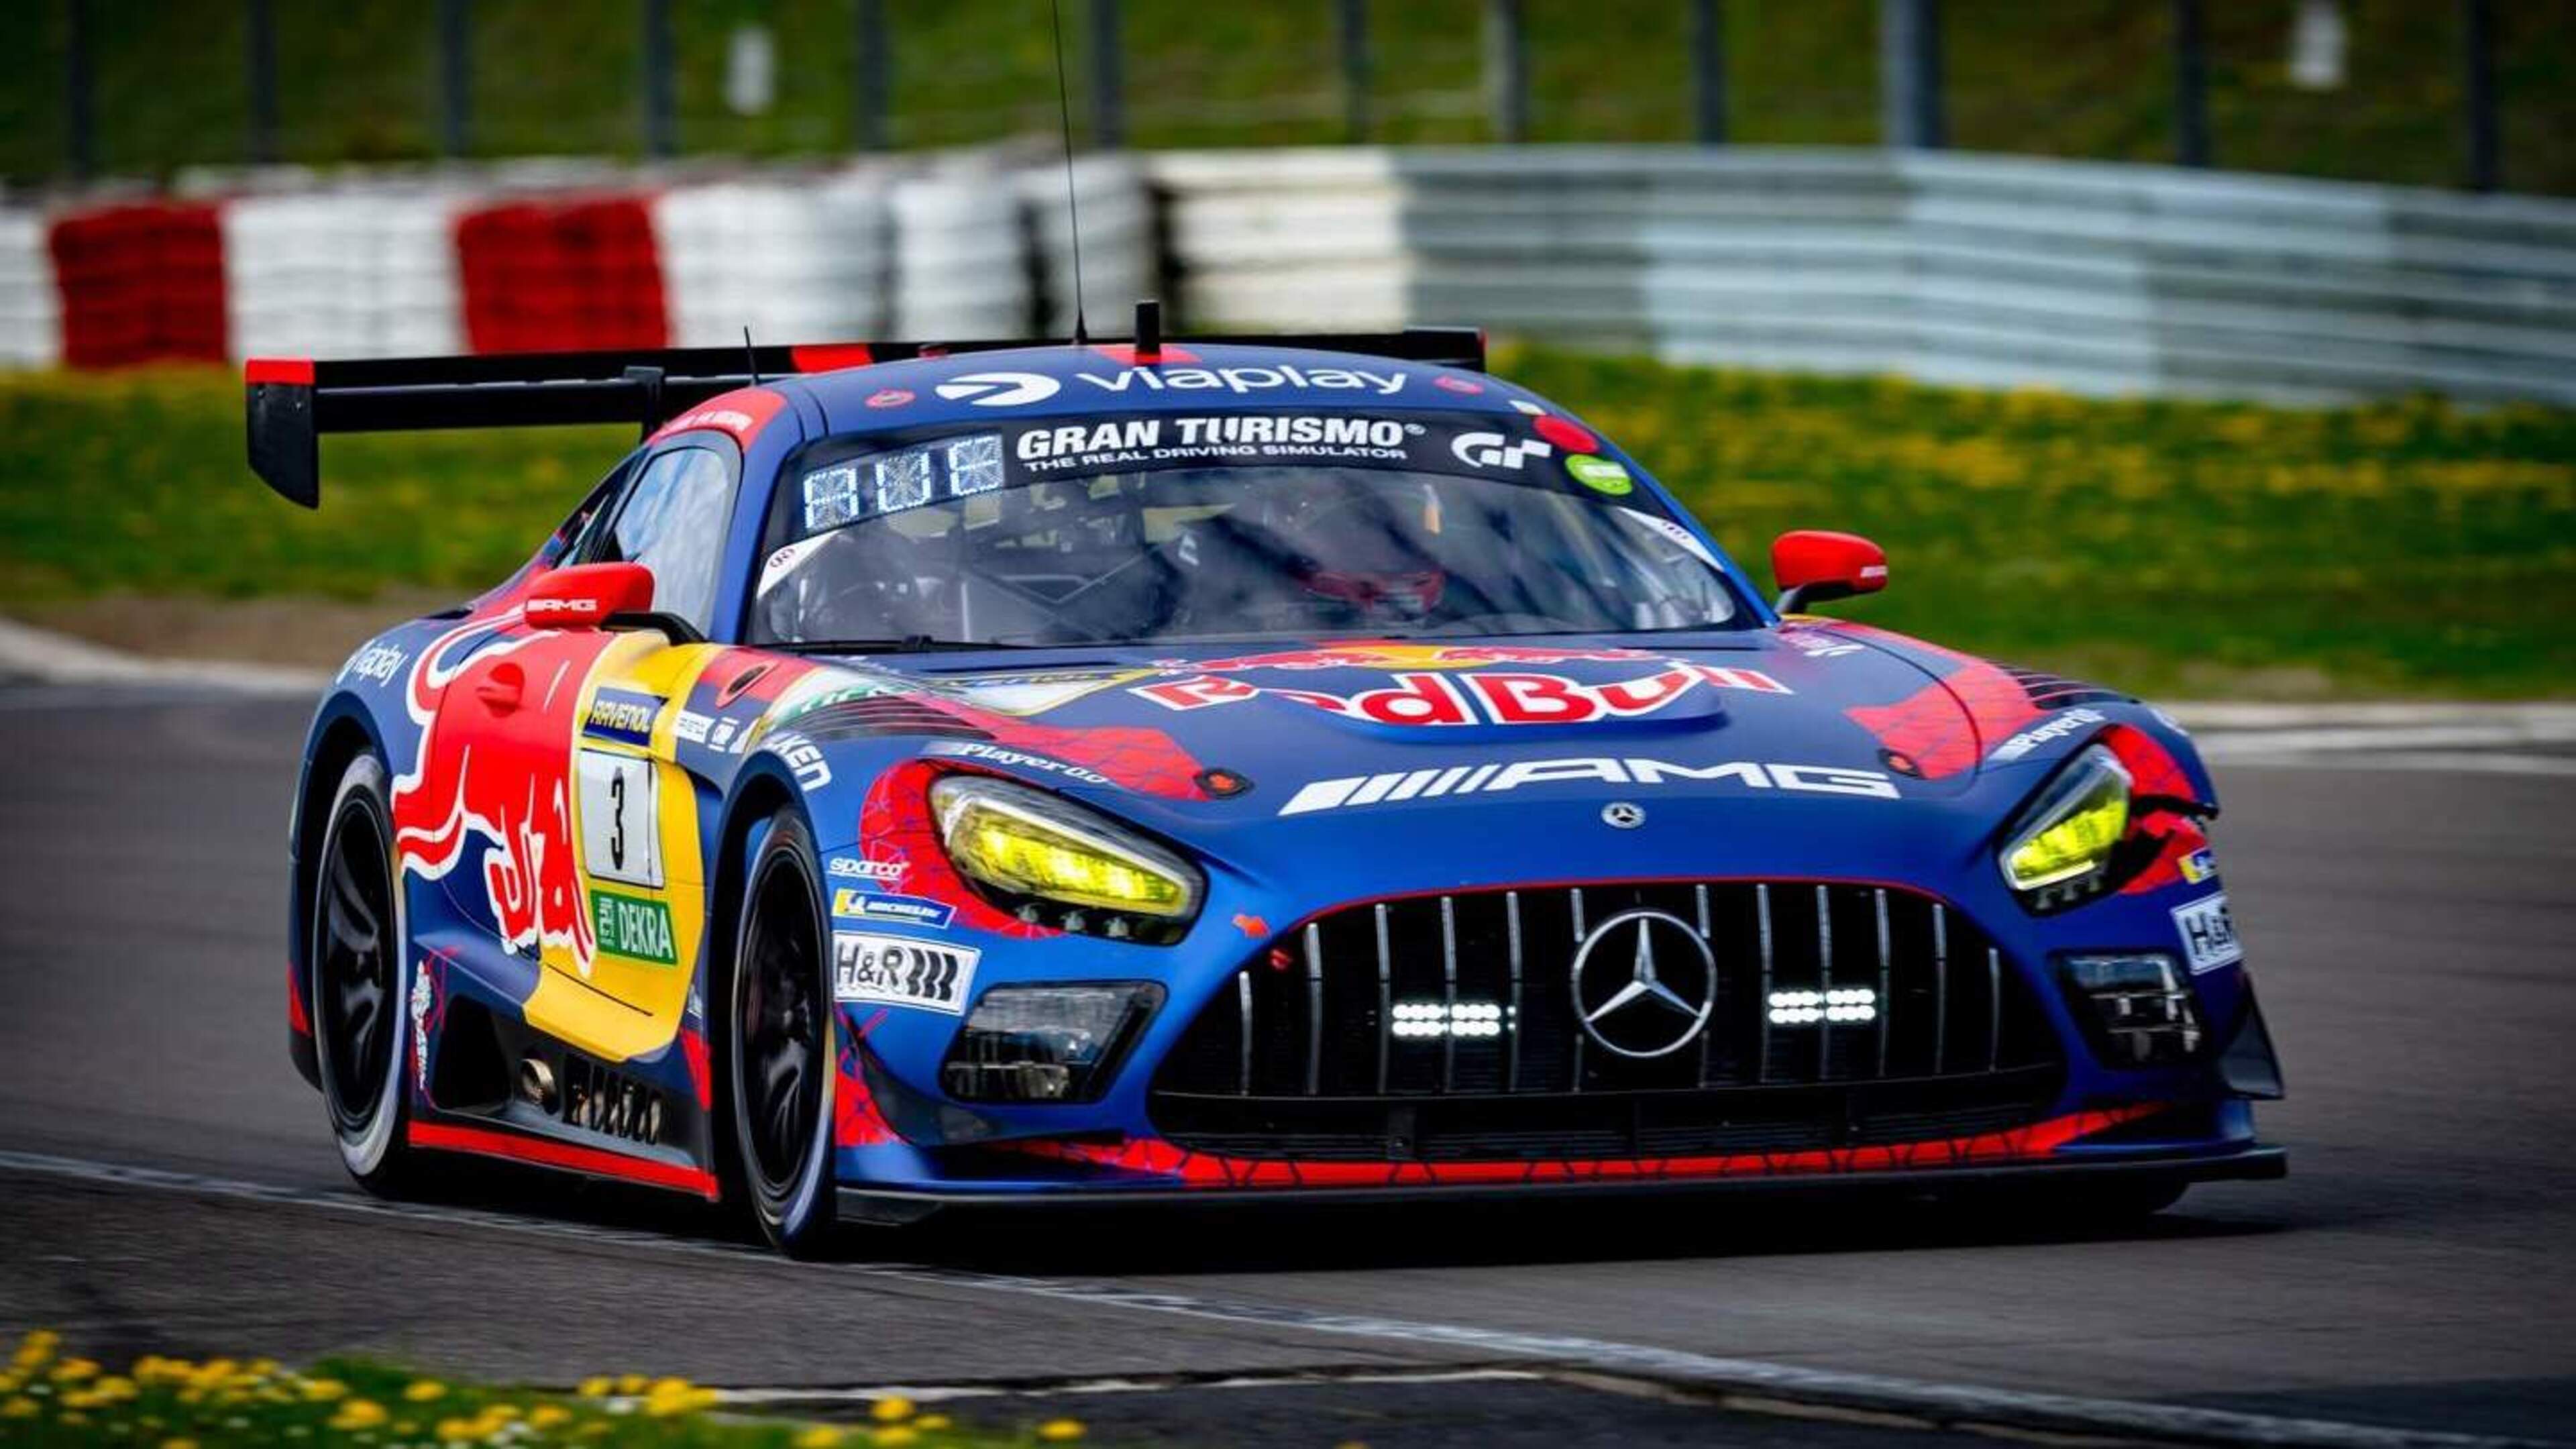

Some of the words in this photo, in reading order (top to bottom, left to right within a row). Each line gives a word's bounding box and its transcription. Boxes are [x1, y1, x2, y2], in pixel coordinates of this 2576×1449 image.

[1076, 366, 1407, 394] viaplay
[1018, 419, 1160, 460] GRAN
[1023, 458, 1077, 472] THE
[1083, 449, 1148, 465] REAL
[1154, 444, 1256, 460] DRIVING
[1263, 443, 1407, 460] SIMULATOR
[541, 598, 597, 612] AMG
[1483, 757, 1901, 799] AMG
[610, 767, 625, 871] 3
[830, 857, 903, 875] sparco
[618, 901, 674, 959] DEKRA
[837, 941, 903, 987] H&R
